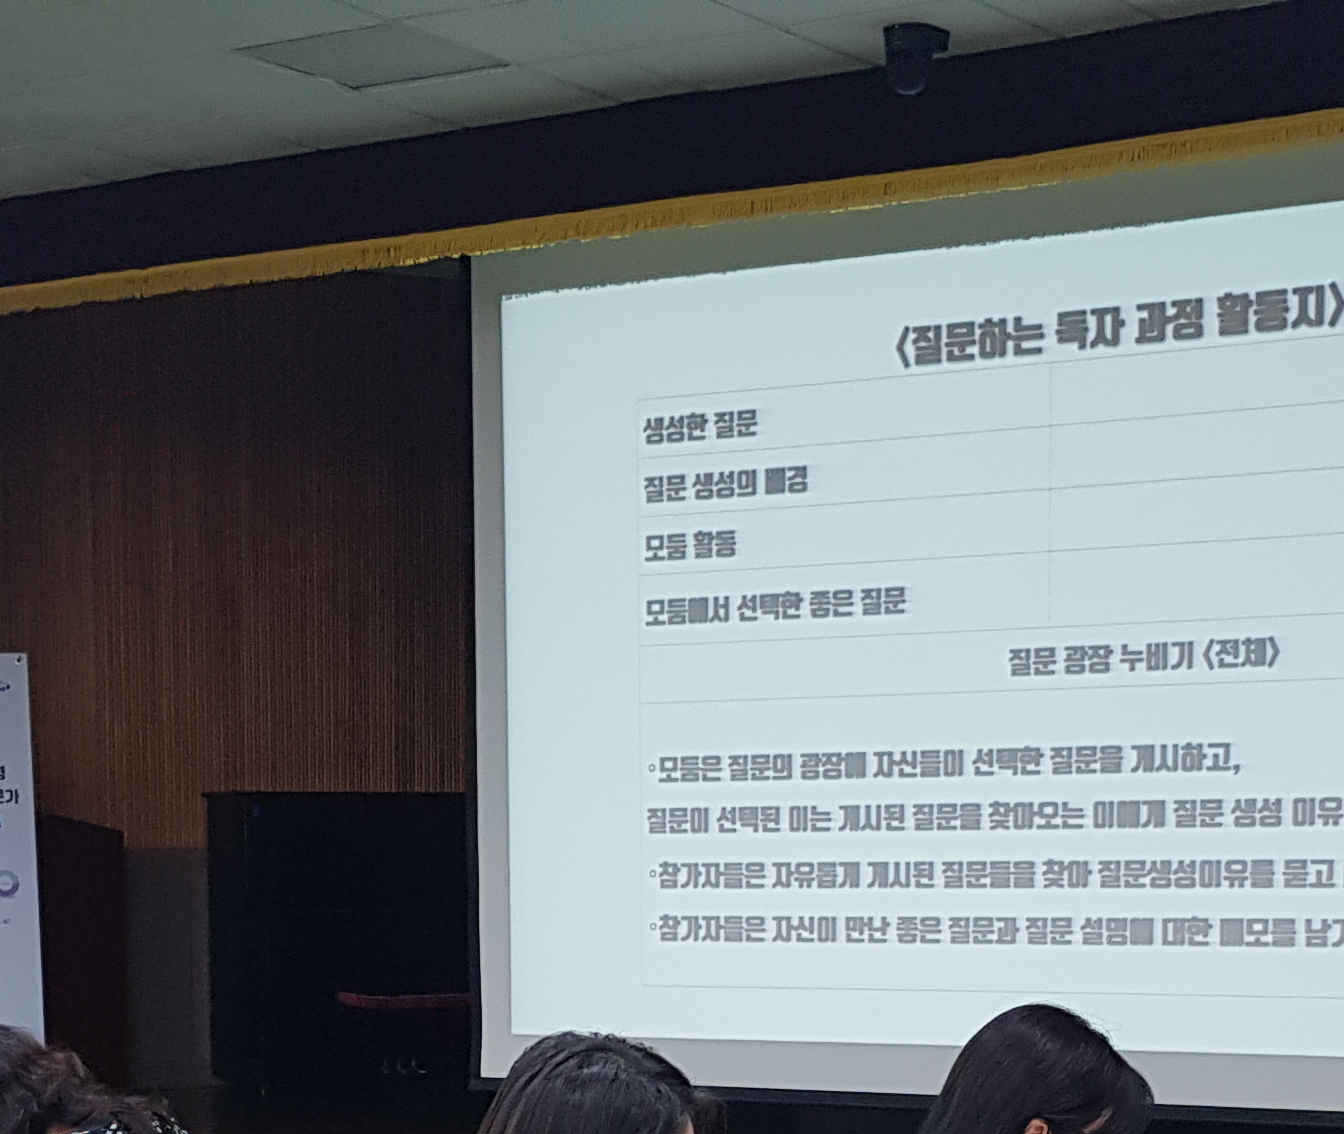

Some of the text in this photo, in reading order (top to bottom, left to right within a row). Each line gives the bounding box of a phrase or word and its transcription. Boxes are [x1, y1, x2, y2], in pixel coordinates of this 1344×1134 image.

[1055, 306, 1126, 351] 독자
[1134, 297, 1205, 346] 과정
[643, 409, 758, 445] 생성한 질문
[644, 474, 688, 503] 질문
[692, 469, 758, 500] 생성의
[645, 530, 737, 562] 모둠 활동
[737, 591, 805, 622] 선택한
[809, 589, 855, 618] 좋은
[860, 586, 907, 616] 질문
[1009, 647, 1057, 677] 질문
[1063, 644, 1114, 675] 광장
[1119, 641, 1194, 672] 누비기
[658, 755, 725, 783] 모둠은
[728, 753, 793, 782] 질문의
[873, 749, 964, 778] 자신들이
[972, 746, 1045, 776] 선택한
[1050, 745, 1124, 775] 질문을
[647, 807, 710, 834] 질문이
[716, 806, 781, 833] 선택된
[789, 805, 835, 833] 이는
[912, 803, 983, 831] 질문을
[988, 801, 1086, 830] 찾아오는
[1173, 799, 1225, 828] 질문
[1230, 798, 1282, 828] 생성
[659, 861, 769, 889] 참가자들은
[772, 861, 861, 889] 자유롭게
[942, 861, 1036, 889] 질문들을
[1042, 859, 1093, 889] 찾아
[1282, 859, 1337, 889] 묻고
[659, 914, 768, 942] 참가자들은
[772, 916, 838, 943] 자신이
[845, 916, 891, 943] 만난
[896, 916, 942, 944] 좋은
[948, 916, 1021, 945] 질문과
[1025, 917, 1074, 945] 질문
[1162, 916, 1213, 946] 대한
